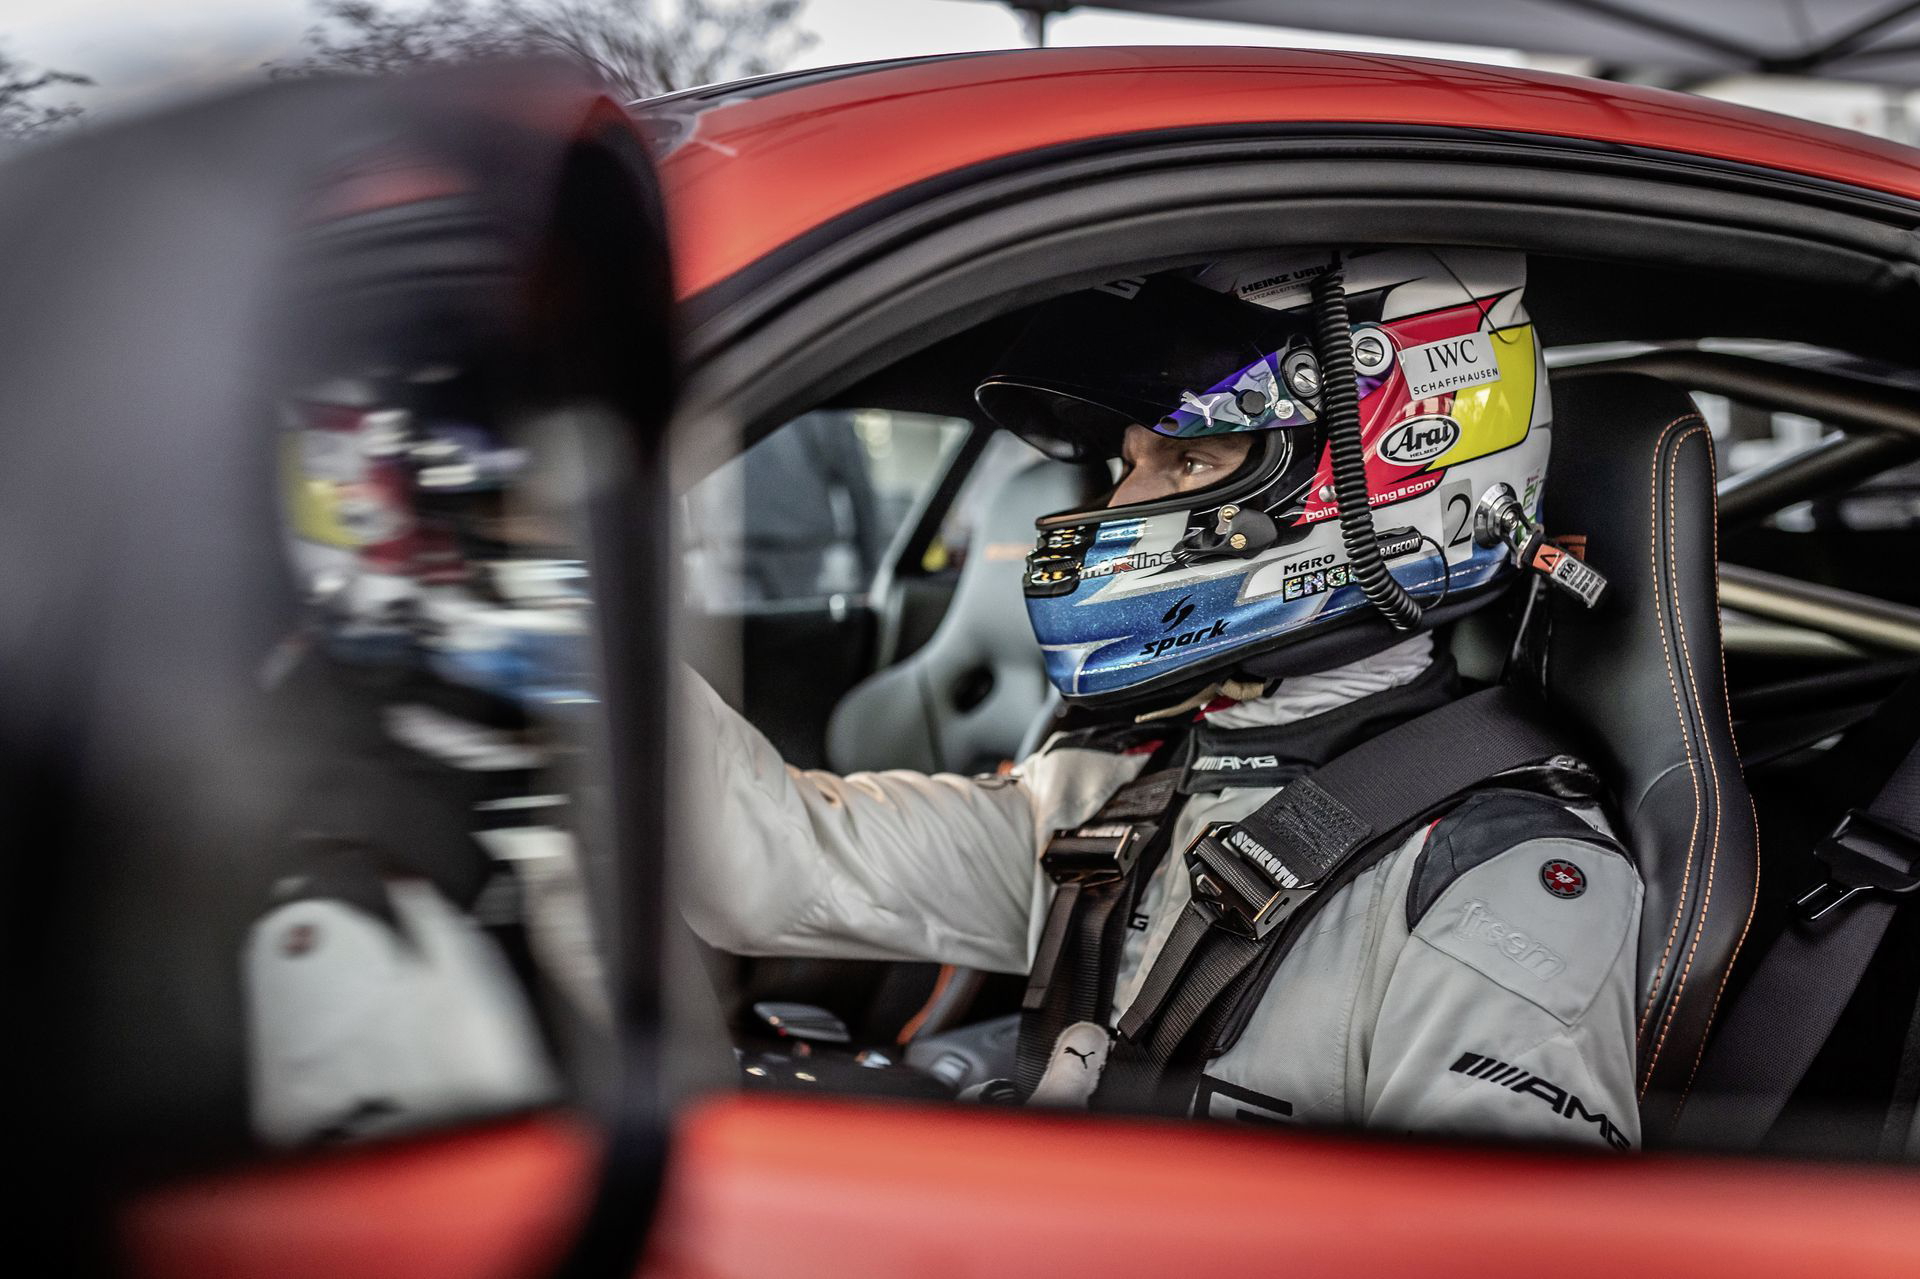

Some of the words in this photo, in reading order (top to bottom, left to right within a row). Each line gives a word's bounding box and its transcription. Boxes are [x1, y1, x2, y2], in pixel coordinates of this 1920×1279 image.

[1241, 274, 1291, 294] HEINZ
[1293, 263, 1338, 280] URB
[1424, 339, 1478, 373] IWC
[1413, 368, 1499, 395] SCHAFFHAUSEN
[1388, 420, 1452, 457] Arai
[1409, 446, 1439, 459] HELMET
[1447, 493, 1473, 549] 2
[1379, 537, 1419, 557] RACECOM
[1283, 553, 1336, 575] MARO
[1282, 563, 1358, 604] ENG
[1139, 618, 1231, 657] spark
[1219, 755, 1279, 771] AMG
[1454, 900, 1567, 982] freem
